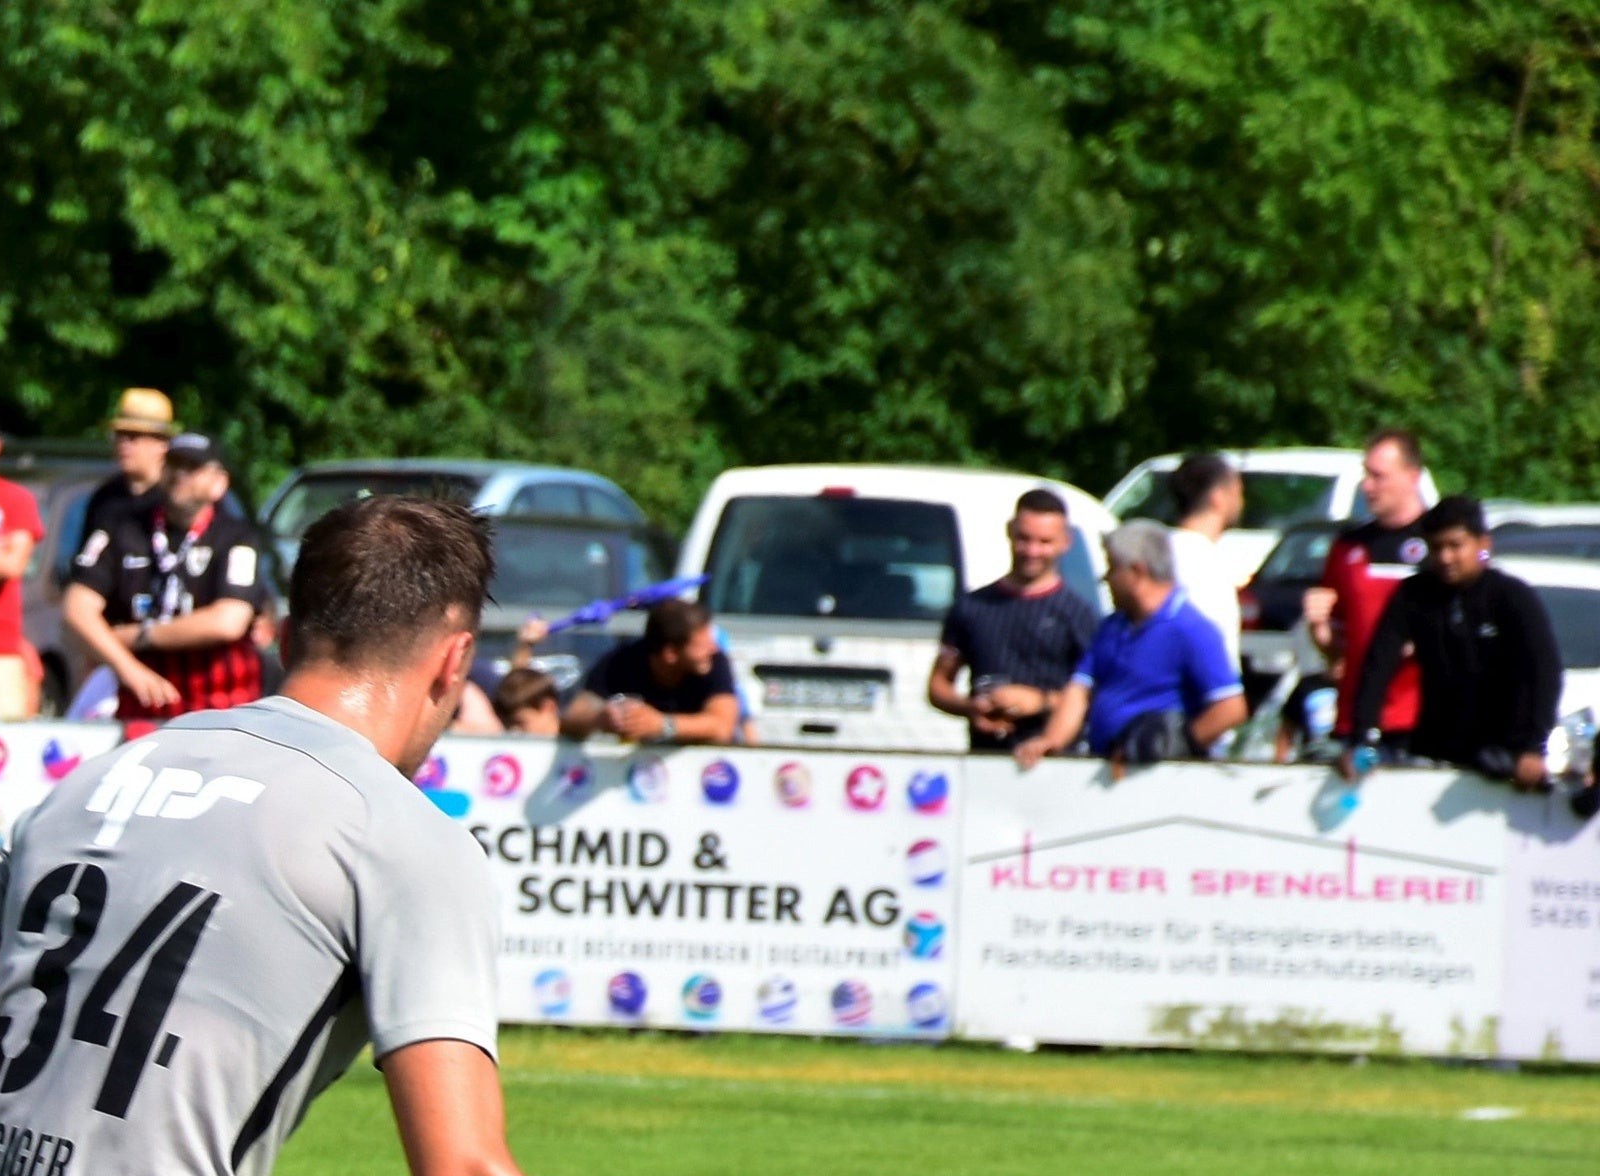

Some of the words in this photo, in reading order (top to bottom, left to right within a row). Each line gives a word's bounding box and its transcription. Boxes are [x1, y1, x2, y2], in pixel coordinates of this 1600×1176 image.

[470, 825, 669, 869] SCHMID
[693, 832, 727, 871] &
[519, 876, 801, 923] SCHWITTER
[824, 888, 901, 926] AG
[1057, 917, 1154, 940] Partner
[1169, 953, 1217, 975] und
